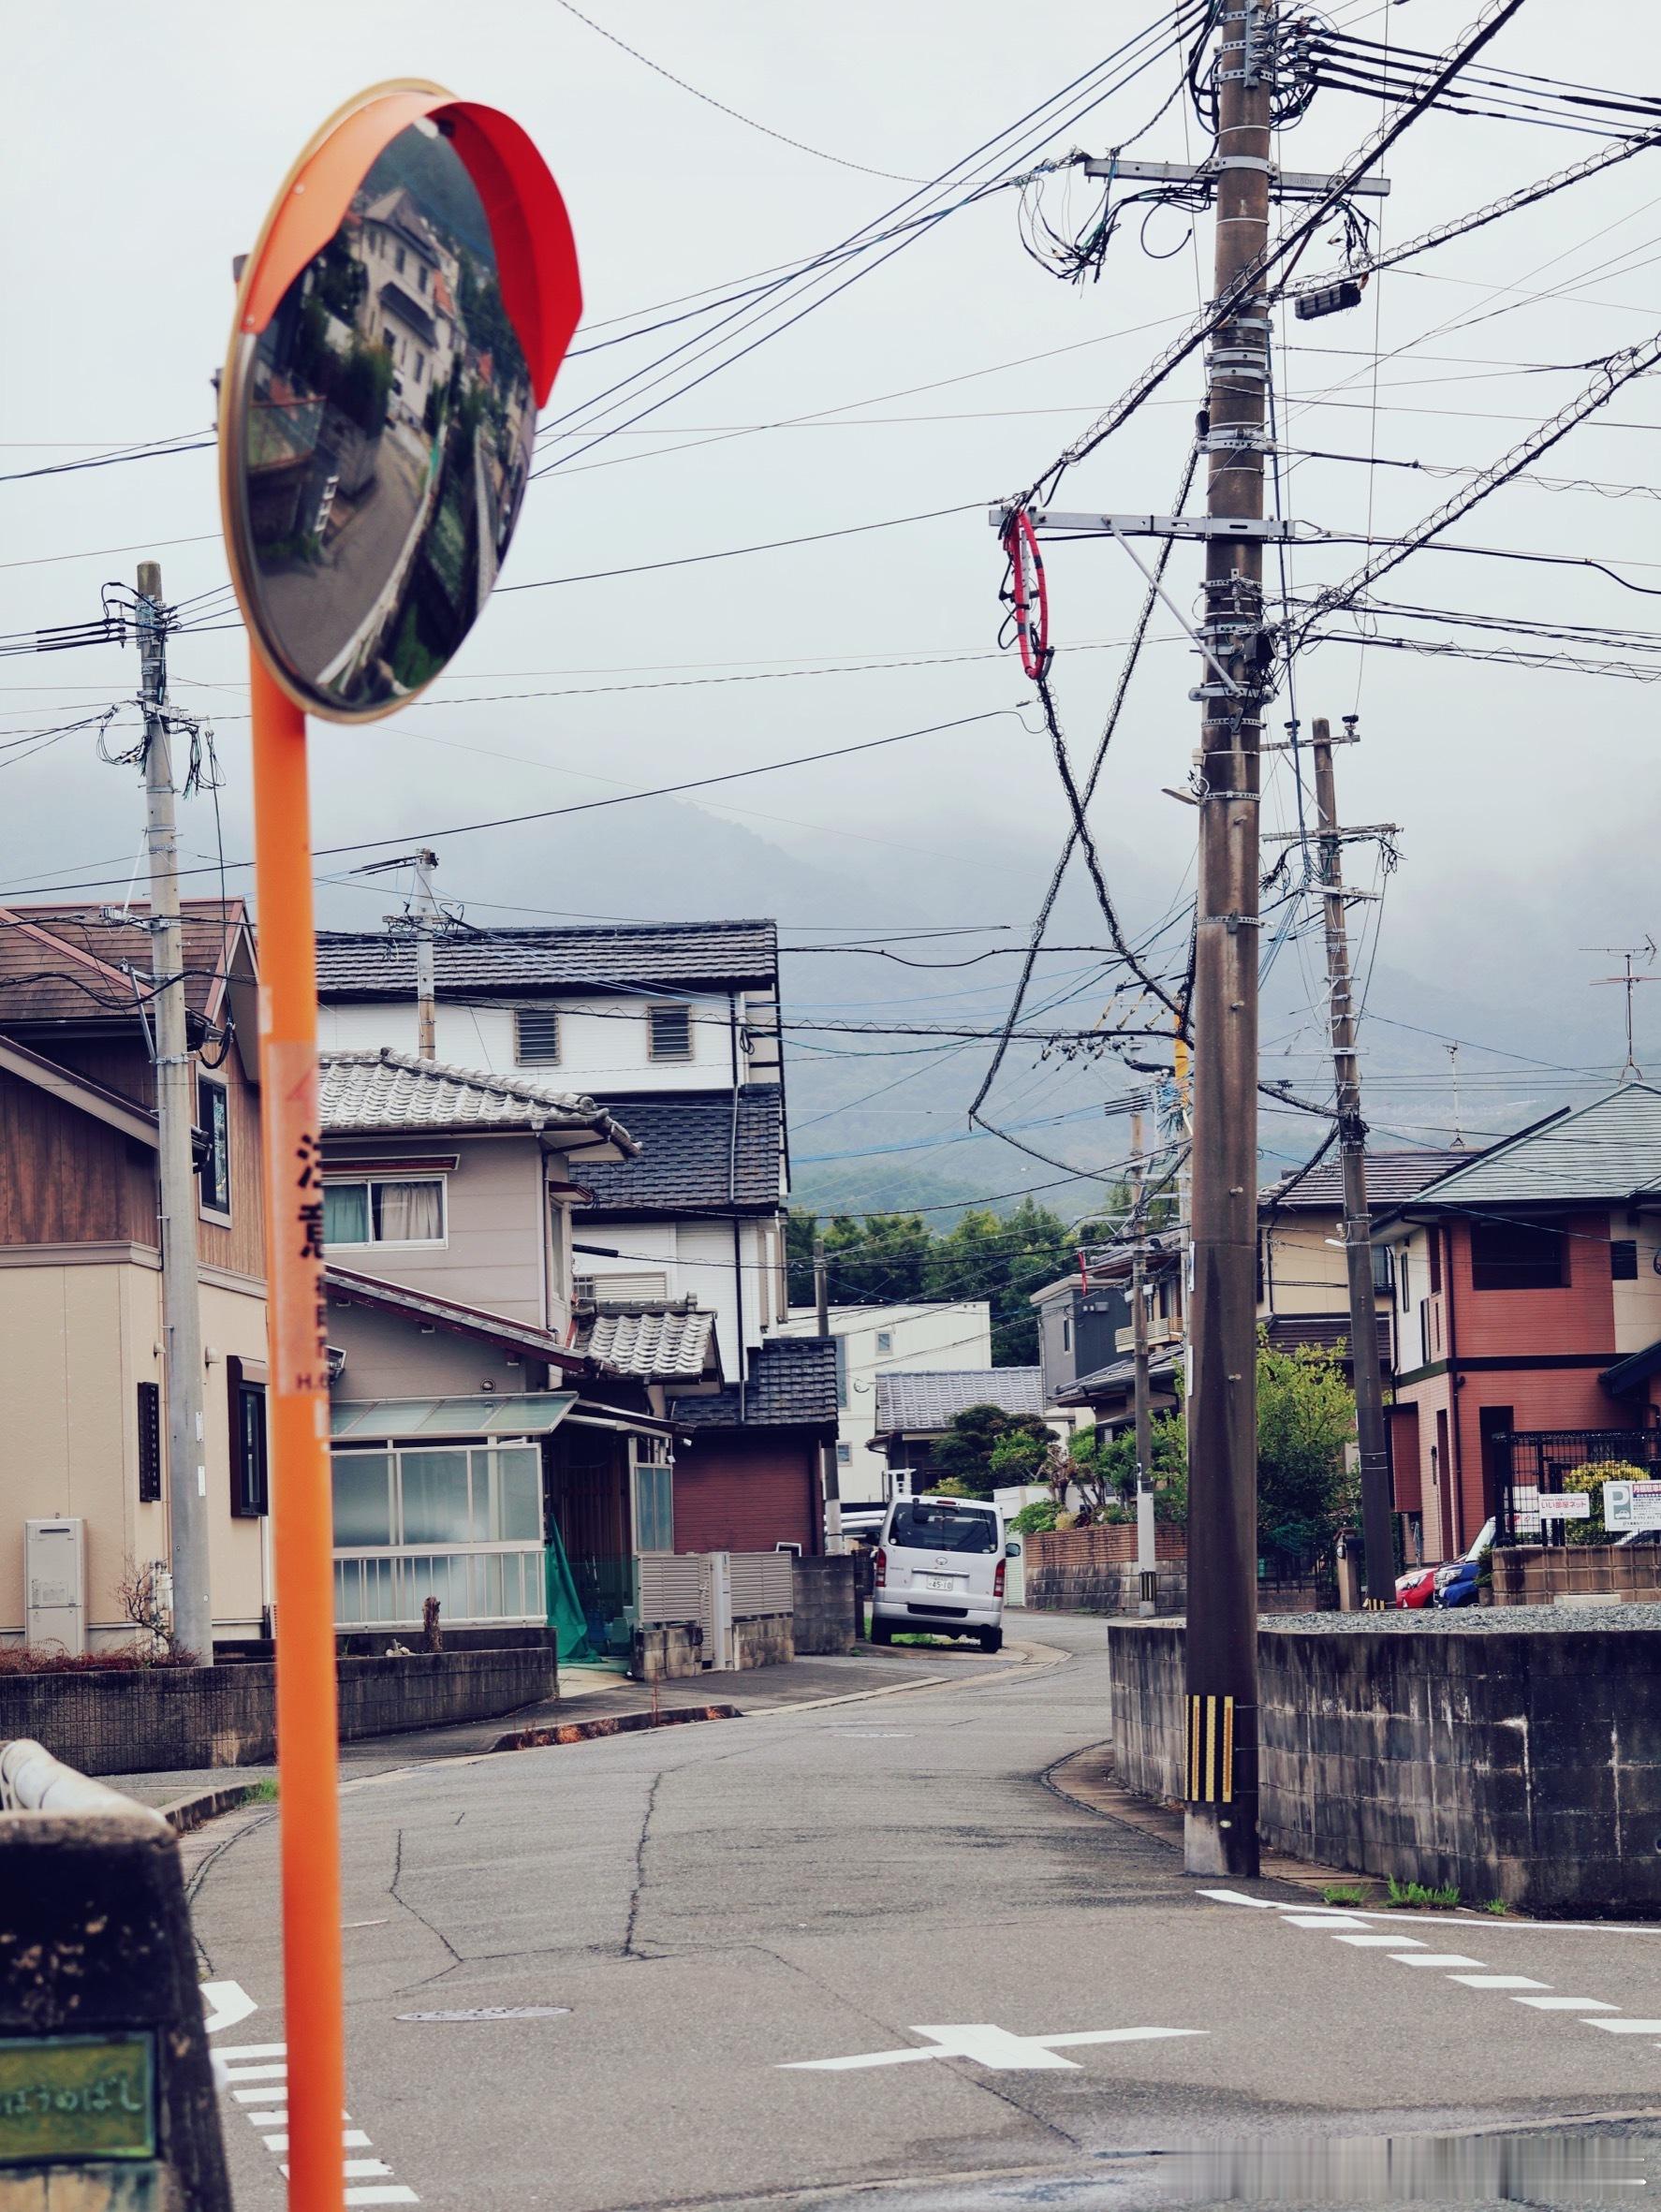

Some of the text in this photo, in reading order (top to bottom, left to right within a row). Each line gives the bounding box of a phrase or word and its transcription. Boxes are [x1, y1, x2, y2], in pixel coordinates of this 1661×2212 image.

[1541, 1501, 1587, 1509] いい部屋ネット
